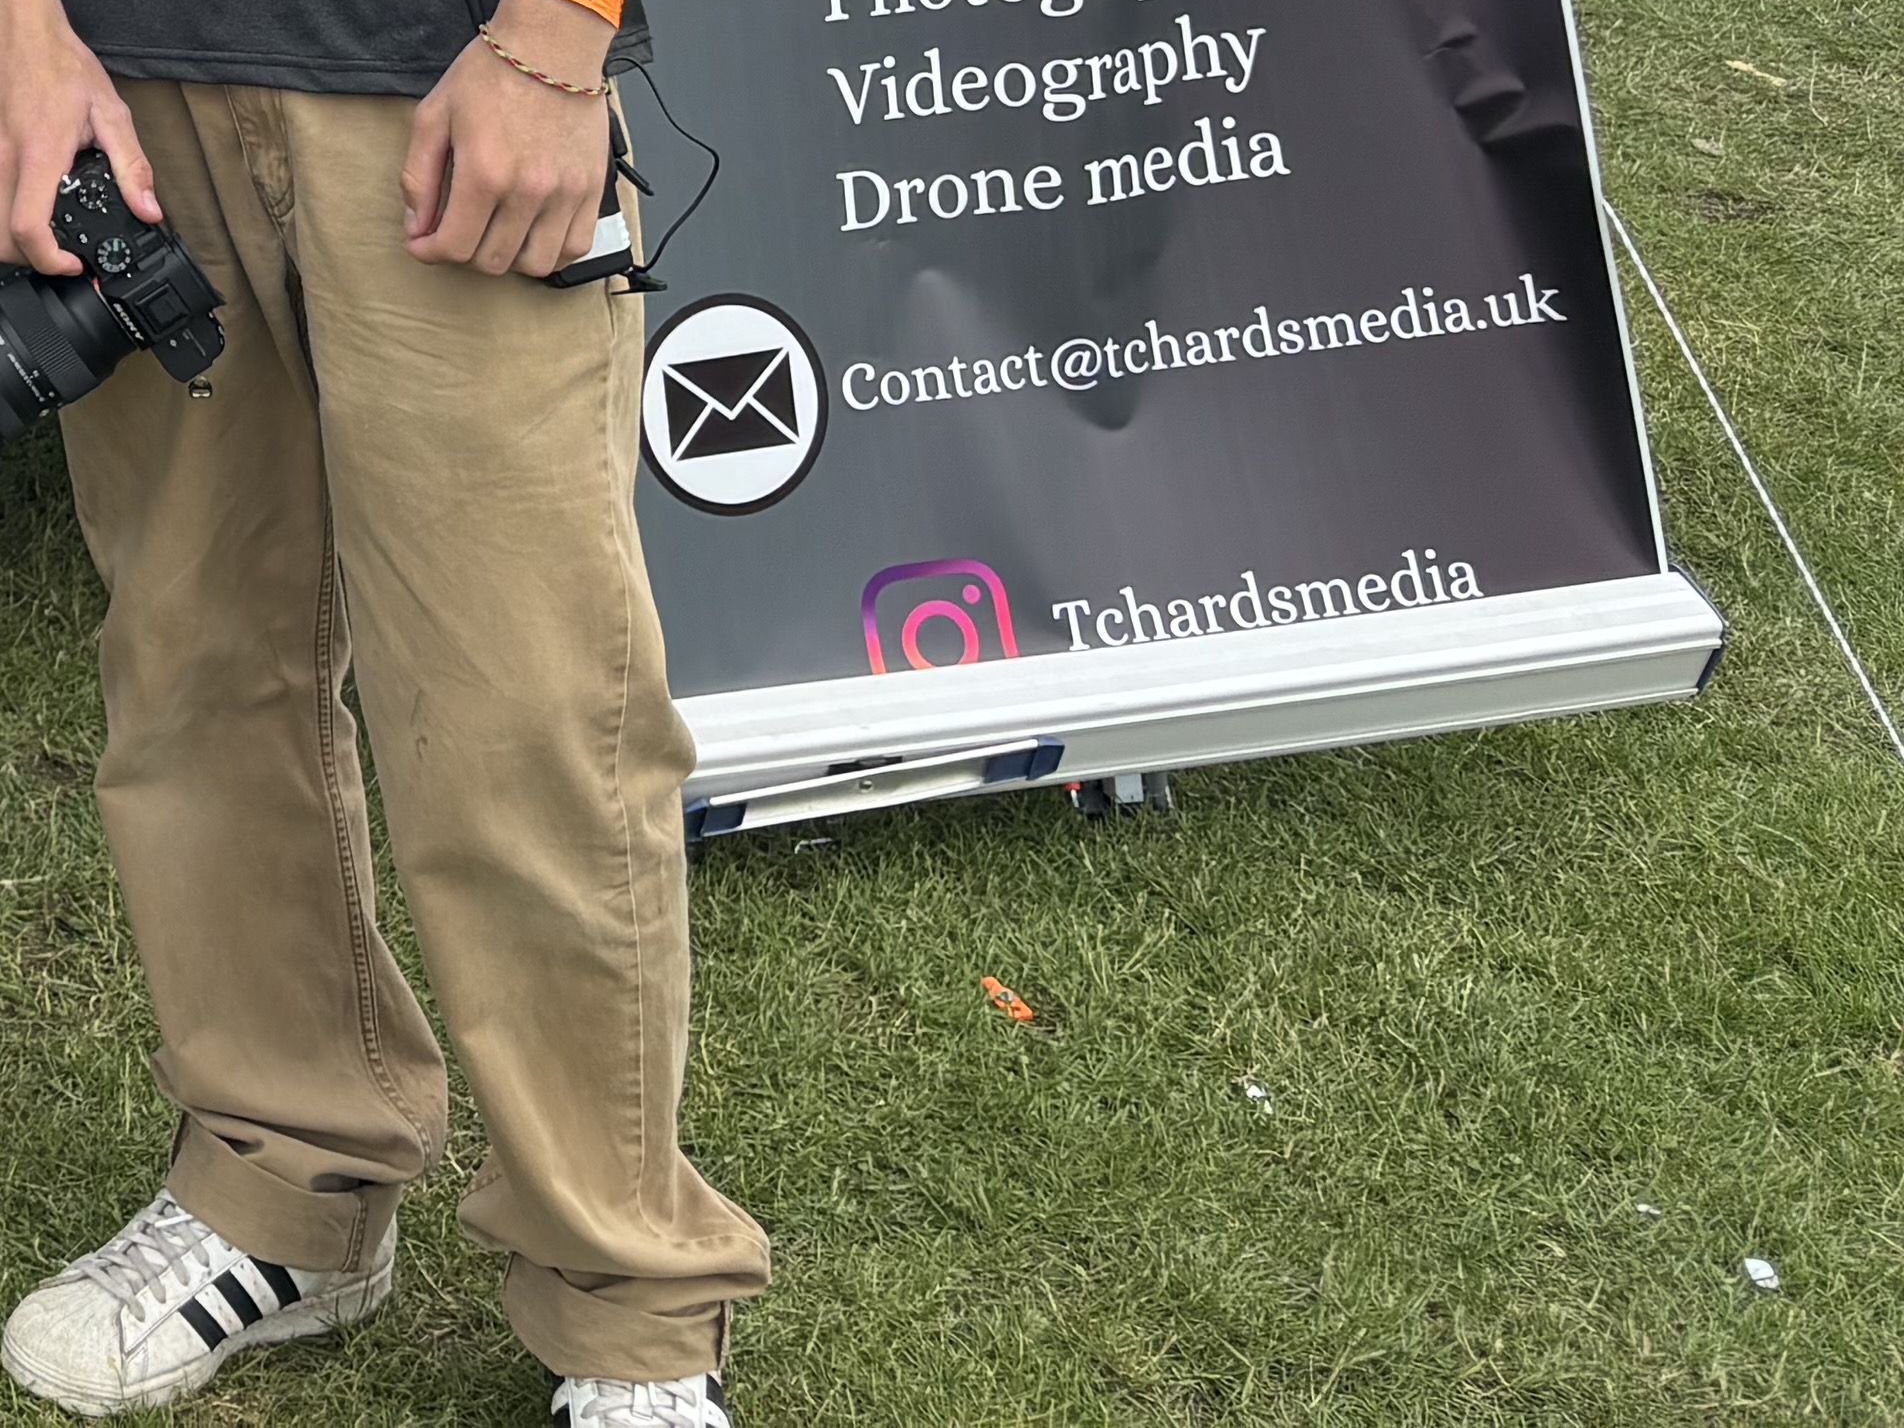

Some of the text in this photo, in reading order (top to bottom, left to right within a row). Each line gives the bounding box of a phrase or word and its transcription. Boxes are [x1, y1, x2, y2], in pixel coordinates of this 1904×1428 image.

[828, 14, 1266, 126] Videography
[837, 116, 1289, 234] Drone media
[112, 302, 144, 342] SONY
[840, 274, 1567, 412] Contact@tchardsmedia.uk
[1054, 549, 1483, 653] Tchardsmedia
